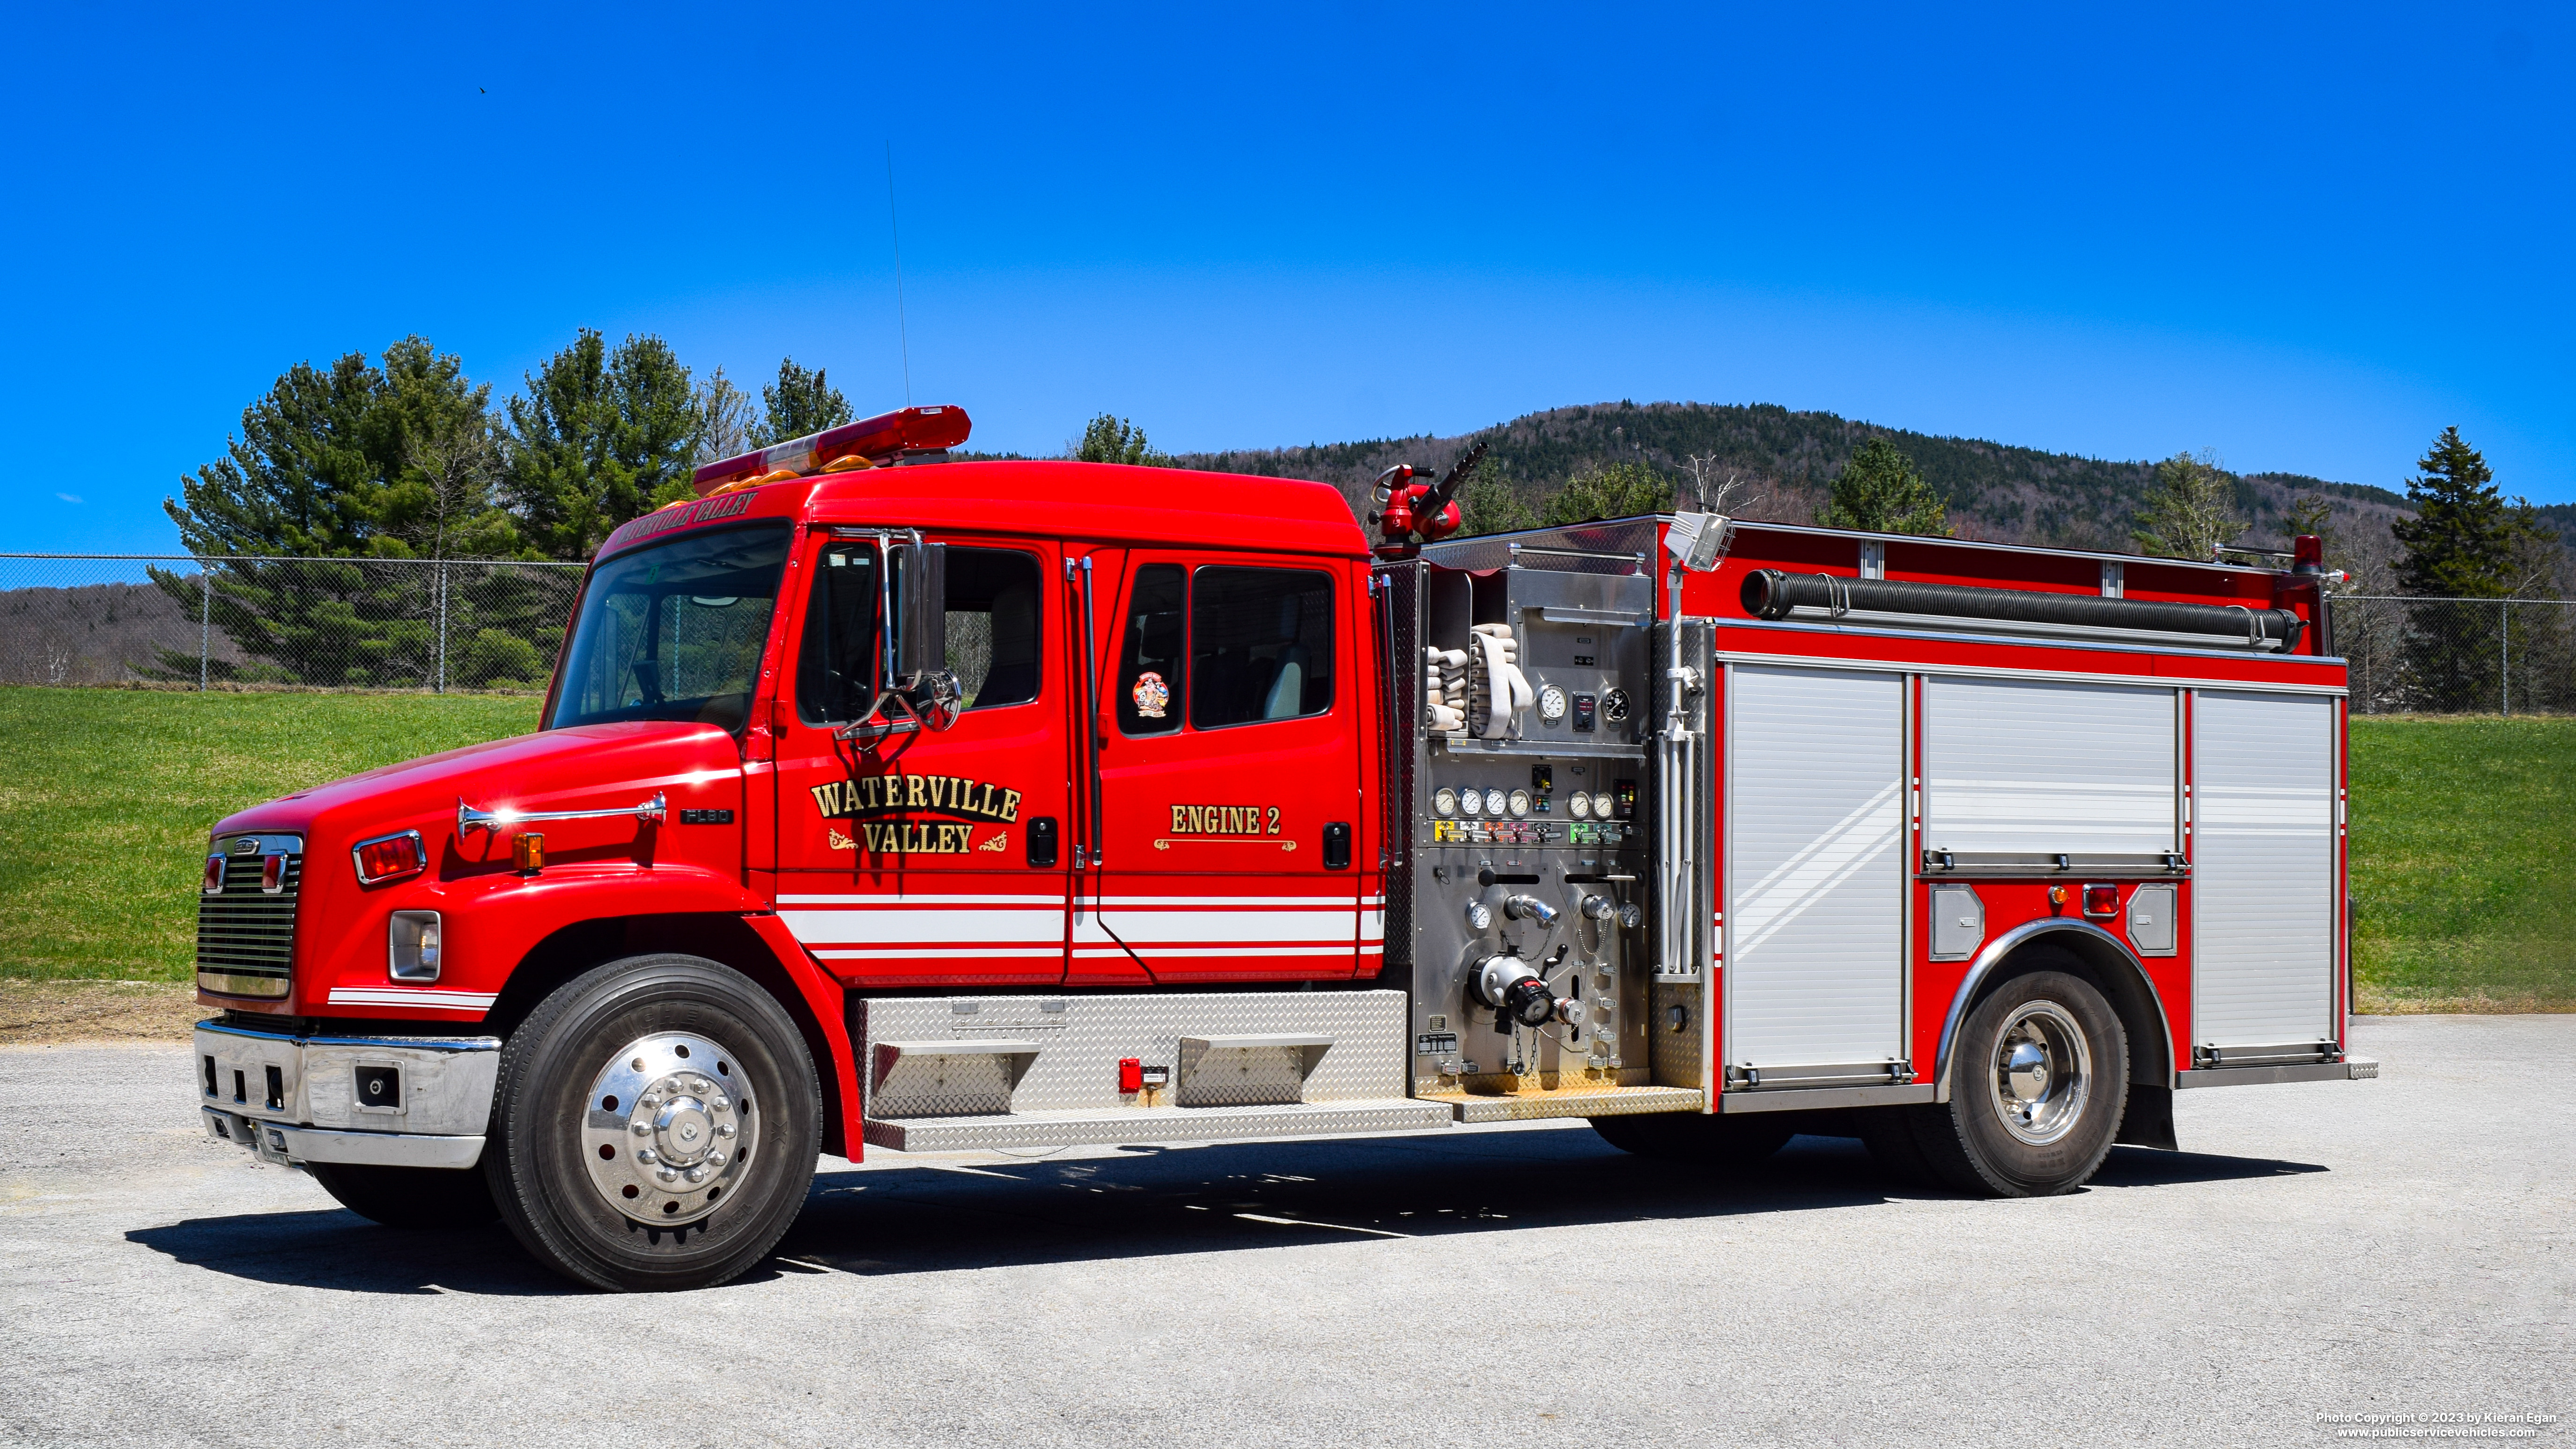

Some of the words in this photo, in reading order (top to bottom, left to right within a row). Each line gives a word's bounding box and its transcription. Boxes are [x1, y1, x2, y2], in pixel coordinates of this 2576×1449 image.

[616, 504, 698, 545] WATERVILLE
[693, 492, 759, 522] VALLEY
[686, 810, 729, 822] FL80
[811, 774, 1022, 823] WATERVILLE
[862, 823, 974, 853] VALLEY
[1171, 805, 1260, 834] ENGINE
[1267, 806, 1280, 834] 2
[598, 1002, 749, 1052] MICHELIN
